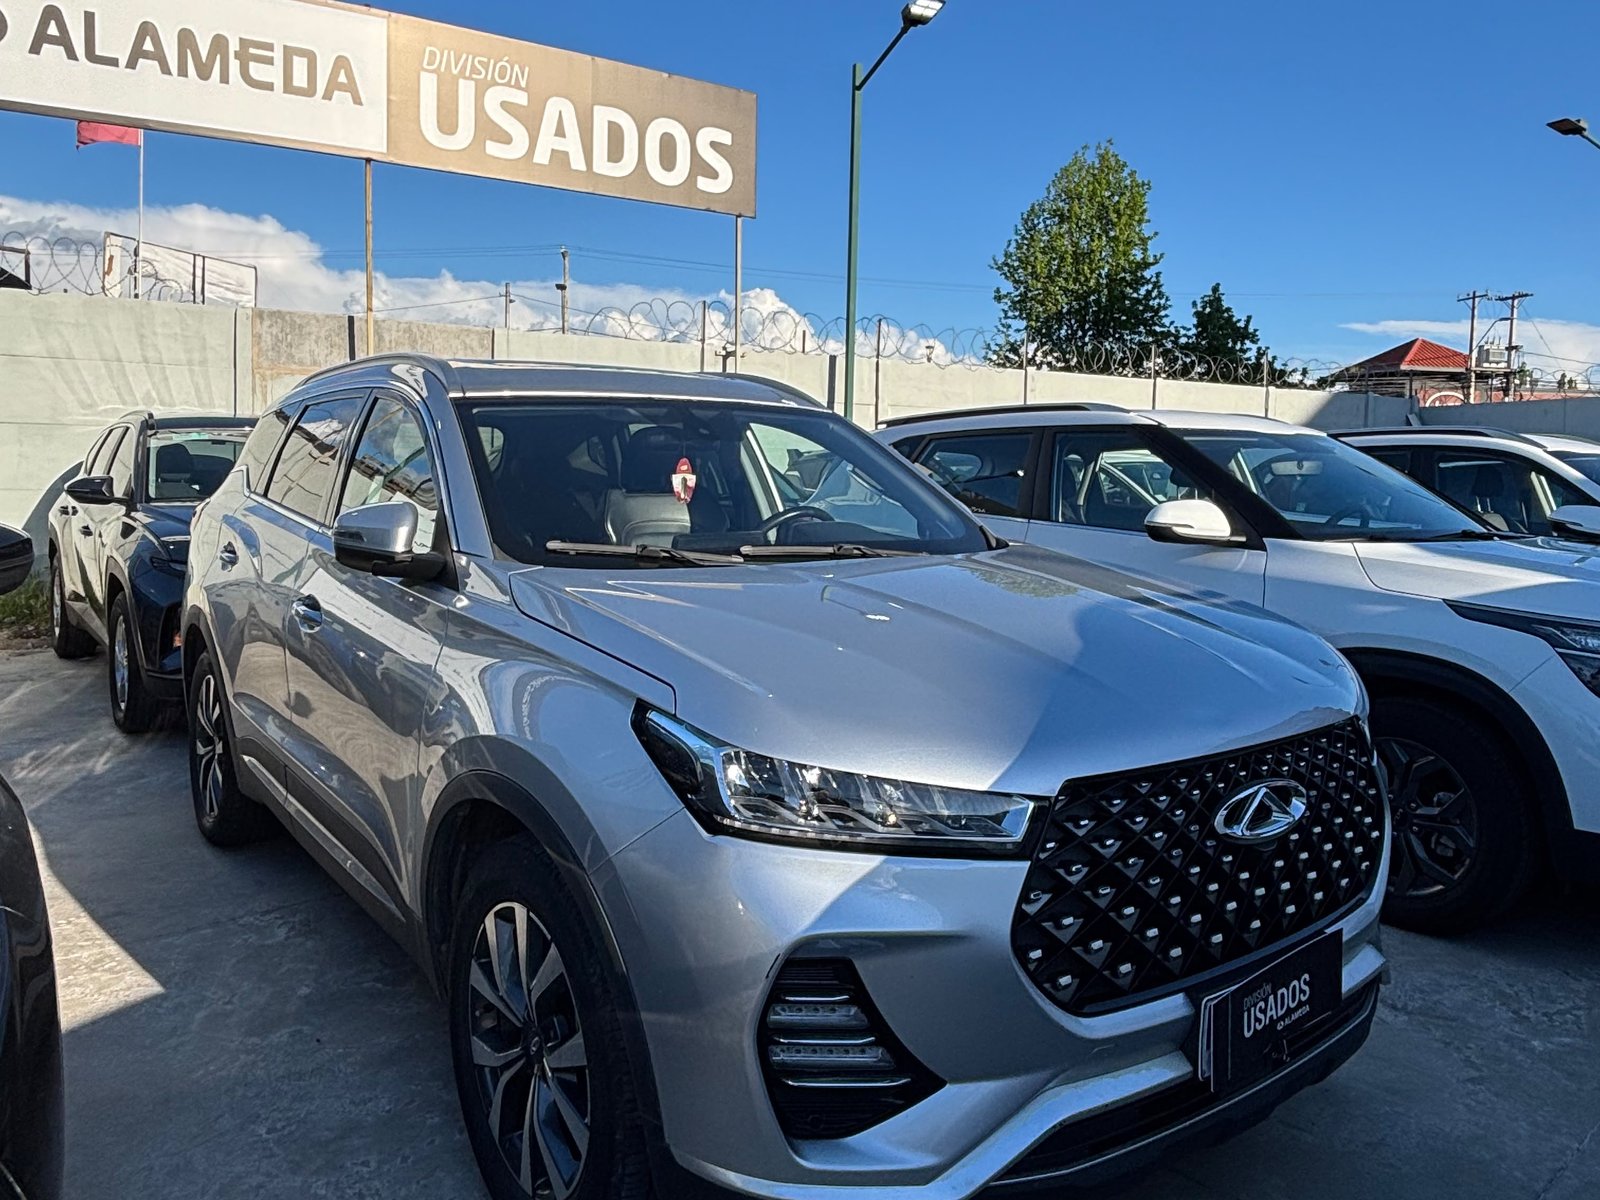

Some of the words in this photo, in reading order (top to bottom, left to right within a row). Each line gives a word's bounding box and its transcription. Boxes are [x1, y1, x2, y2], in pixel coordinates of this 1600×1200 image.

[28, 4, 364, 106] ALAMEDA
[421, 46, 529, 88] DIVISIÓN
[419, 71, 734, 194] USADOS
[1244, 973, 1310, 1038] USADOS
